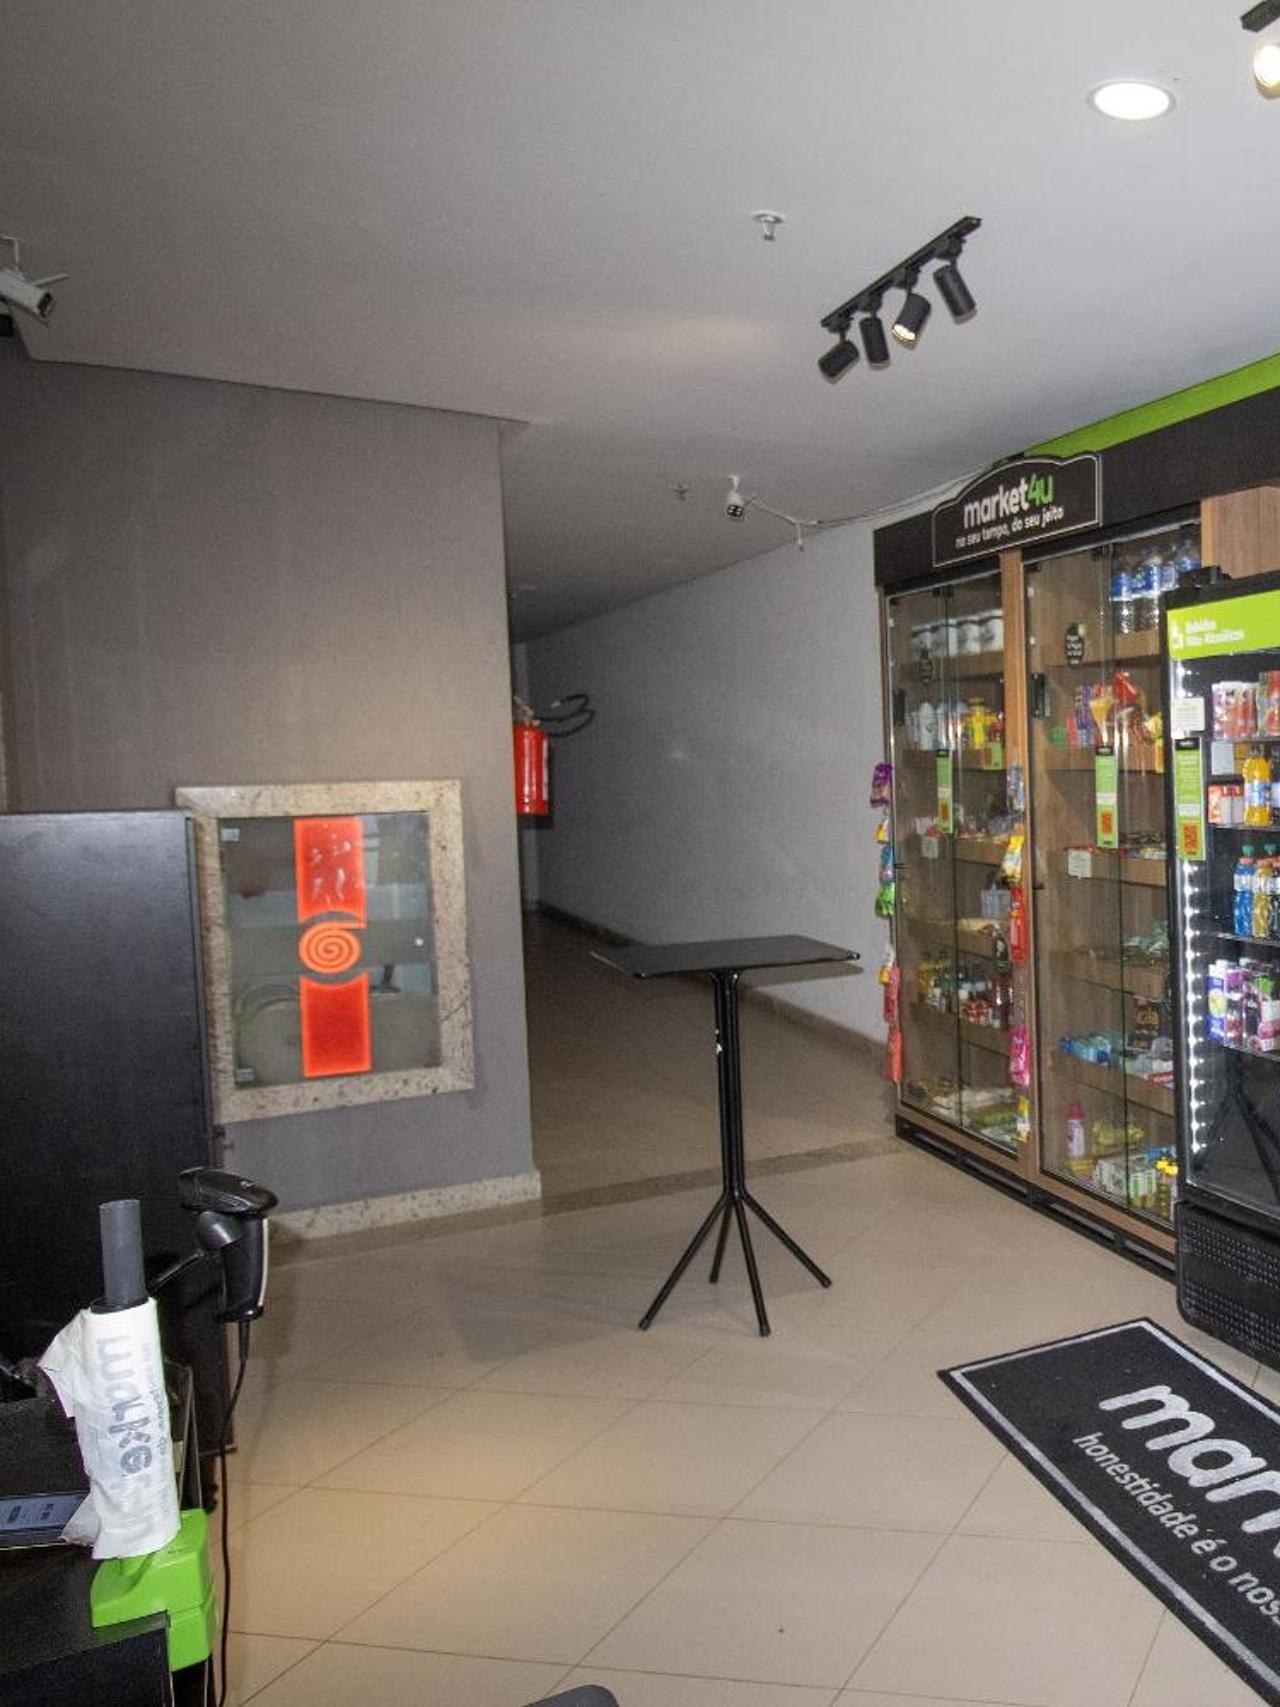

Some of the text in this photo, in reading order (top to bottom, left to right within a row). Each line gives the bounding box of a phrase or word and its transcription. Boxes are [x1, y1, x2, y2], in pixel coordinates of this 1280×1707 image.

[1024, 514, 1040, 529] seu
[1040, 505, 1064, 529] jeito
[1072, 1431, 1199, 1538] honestidade
[1191, 1537, 1228, 1554] é
[1210, 1556, 1238, 1572] o
